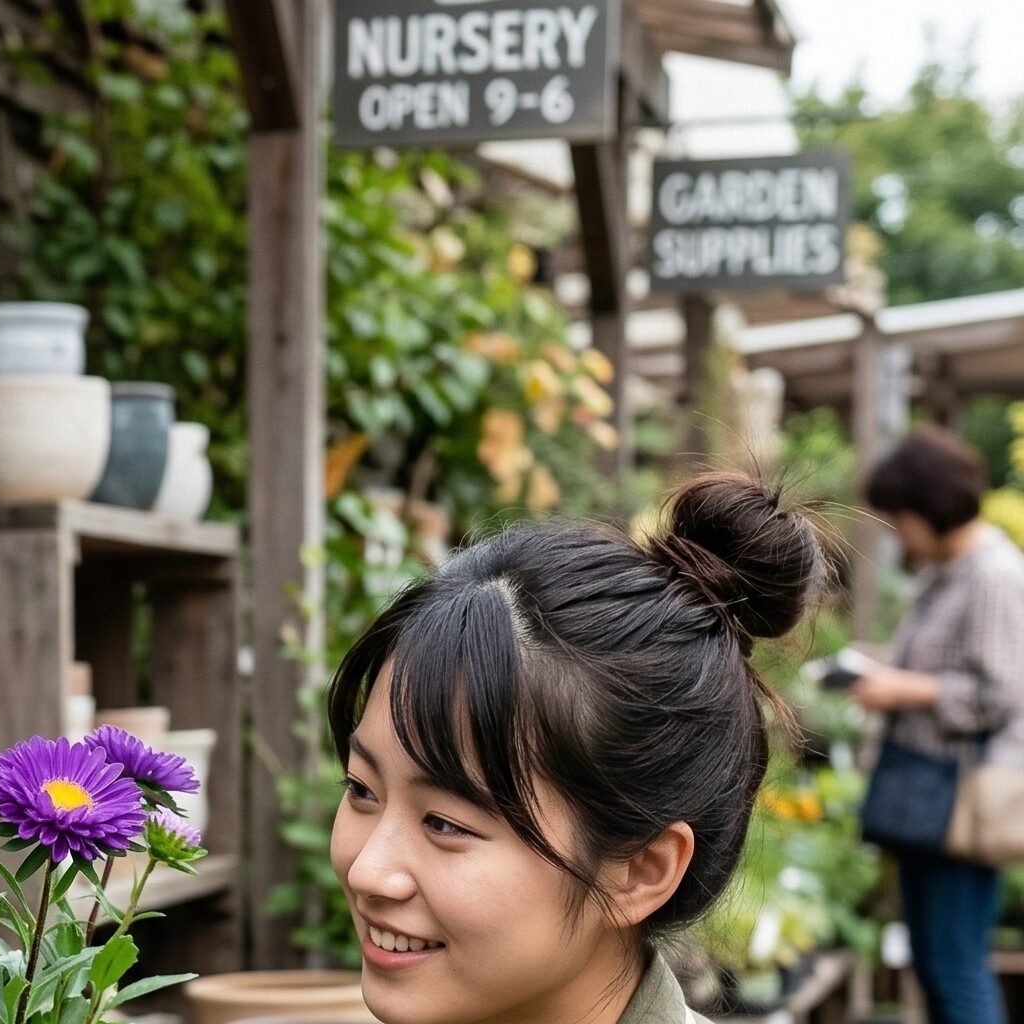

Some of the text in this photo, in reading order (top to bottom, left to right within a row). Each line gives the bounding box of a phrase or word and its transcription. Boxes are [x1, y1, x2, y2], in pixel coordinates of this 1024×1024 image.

[348, 5, 598, 79] NURSERY
[358, 76, 575, 131] OPEN 9-6
[658, 167, 839, 225] GARDEN
[653, 223, 840, 278] SUPPLIES
